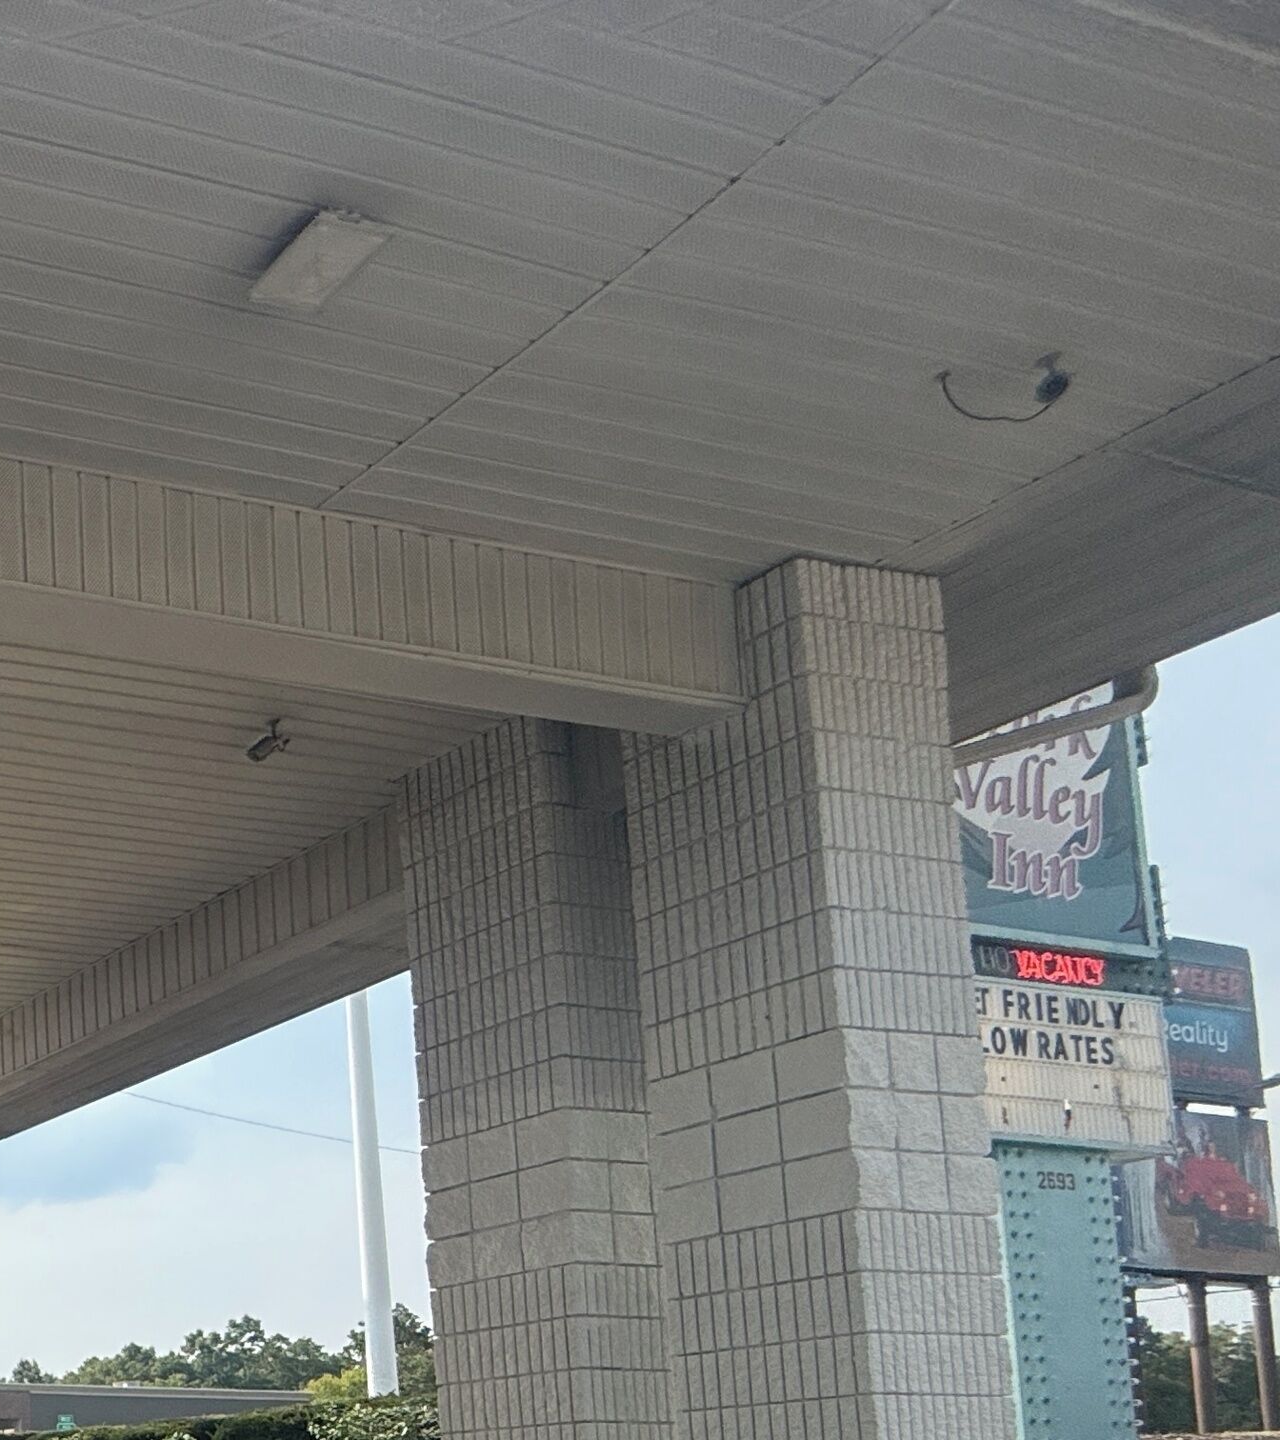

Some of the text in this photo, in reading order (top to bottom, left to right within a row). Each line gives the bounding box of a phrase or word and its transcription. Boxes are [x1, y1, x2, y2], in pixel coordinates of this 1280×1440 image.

[957, 754, 1101, 855] Valley
[991, 831, 1082, 898] Inn
[1011, 950, 1104, 986] VACANCY
[1002, 989, 1125, 1029] FRIENDLY
[1037, 1031, 1114, 1065] RATES
[1163, 1020, 1228, 1053] eality
[1036, 1171, 1076, 1191] 2693
